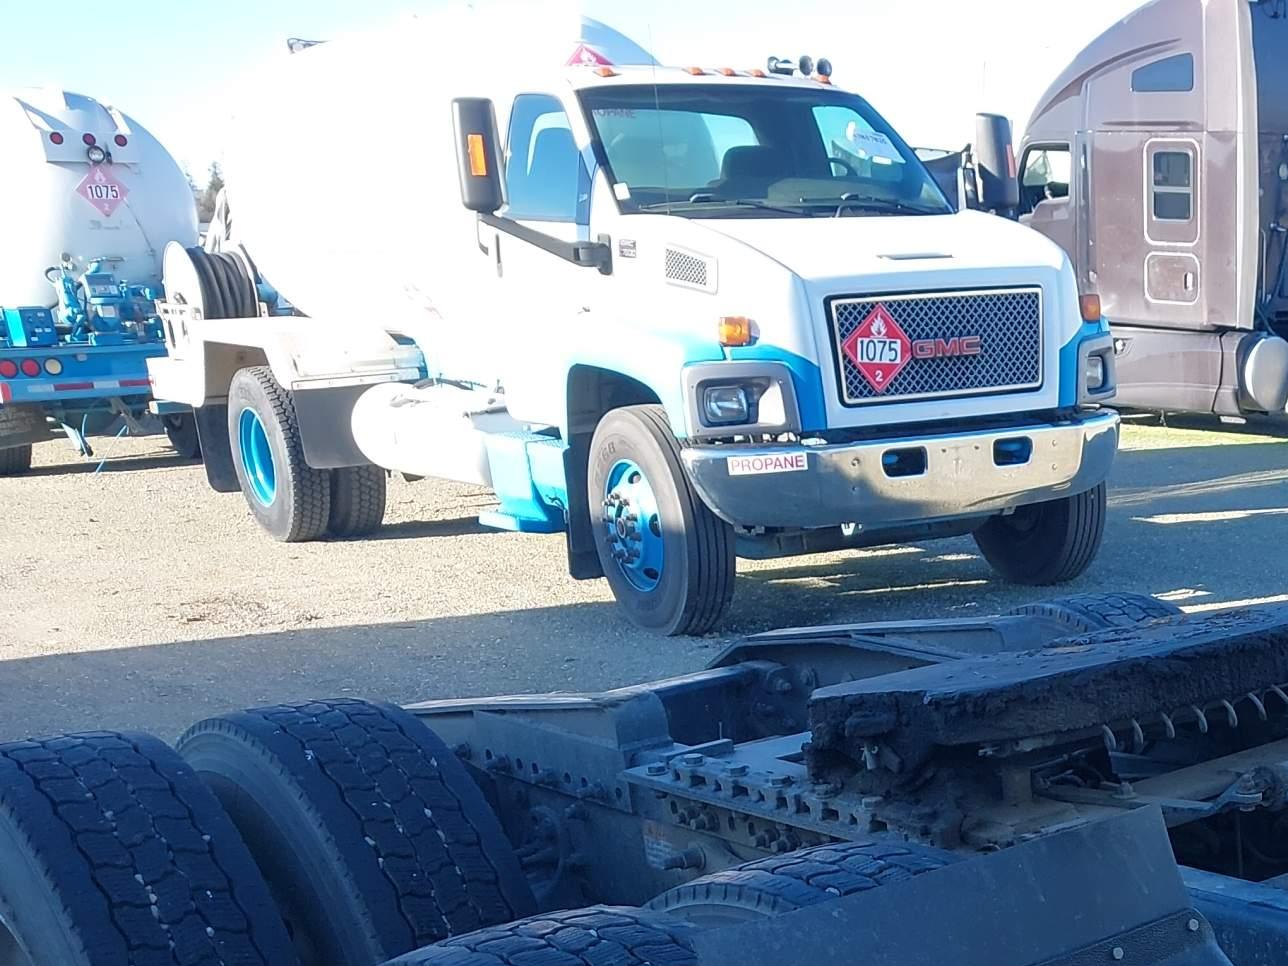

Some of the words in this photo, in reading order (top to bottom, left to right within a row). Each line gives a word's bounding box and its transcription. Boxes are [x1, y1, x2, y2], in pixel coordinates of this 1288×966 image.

[88, 185, 119, 199] 1075
[859, 340, 898, 362] 1075
[911, 335, 982, 361] GMC
[875, 369, 884, 383] 2
[730, 455, 805, 473] PROPANE
